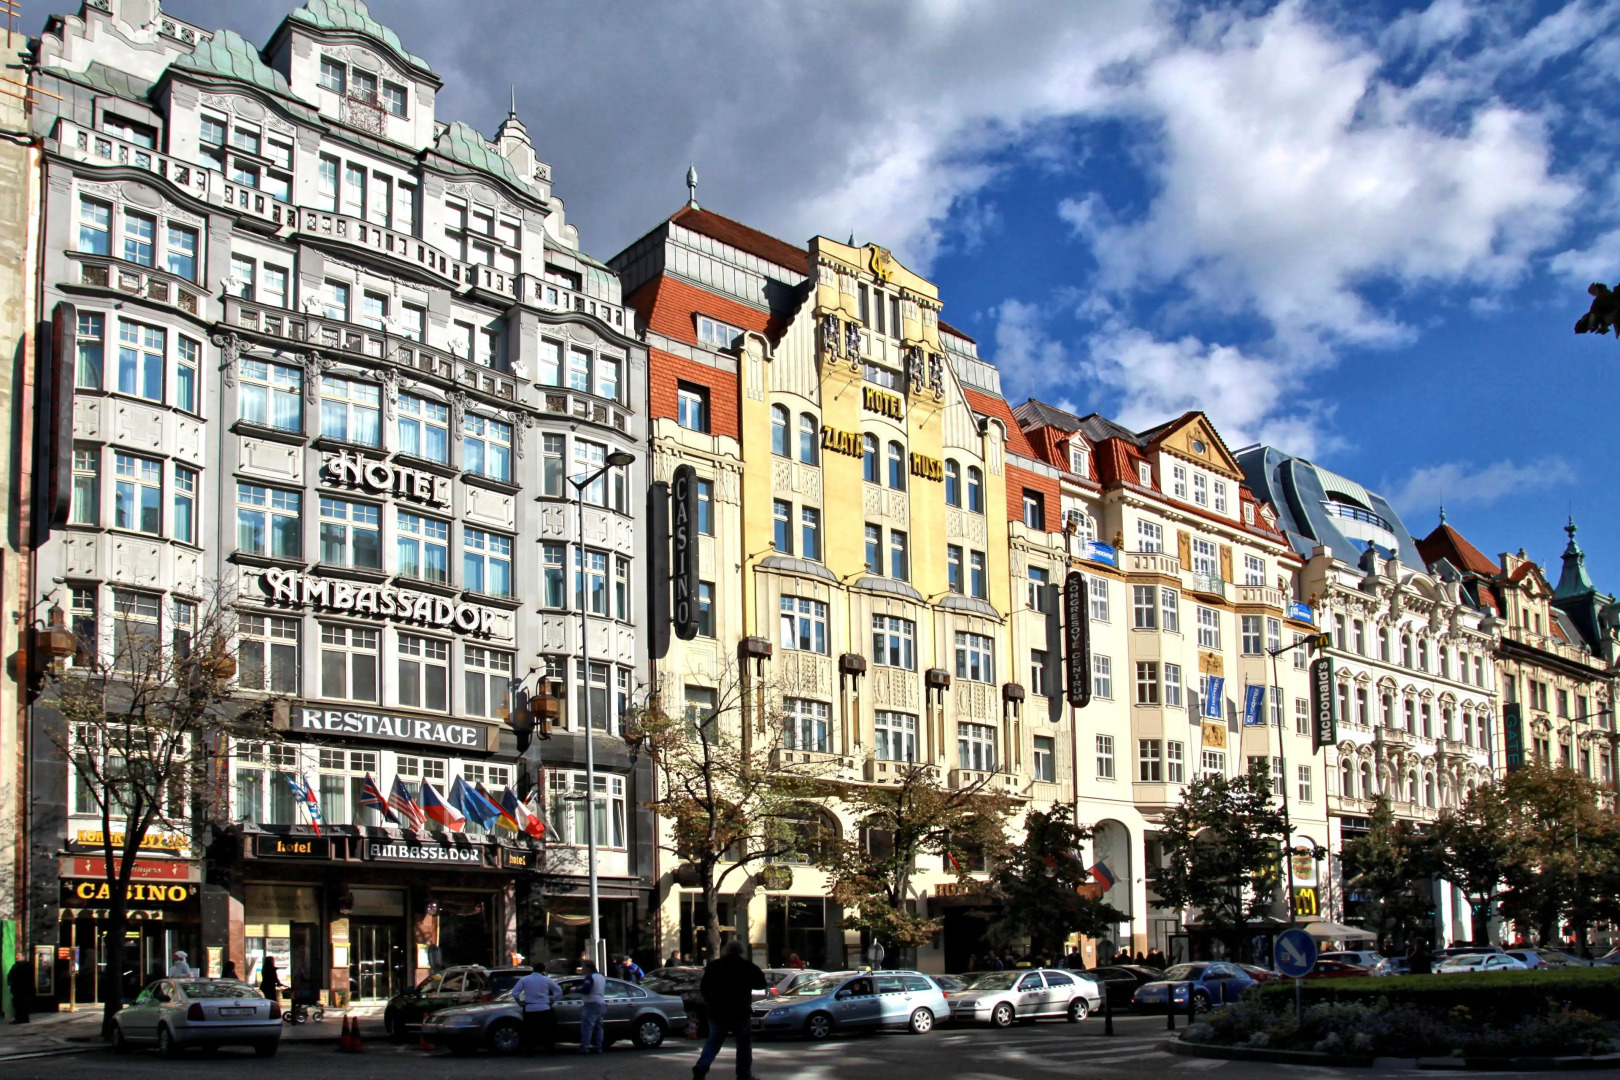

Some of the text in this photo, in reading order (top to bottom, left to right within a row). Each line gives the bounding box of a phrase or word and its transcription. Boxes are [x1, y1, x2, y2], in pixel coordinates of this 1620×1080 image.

[865, 386, 904, 420] HOTEL
[328, 449, 449, 505] HOTEL
[911, 452, 944, 482] HUSA
[675, 477, 689, 625] CASINO
[265, 567, 497, 635] AMBASSADOR
[1071, 653, 1083, 702] CENTRUM
[1318, 661, 1332, 742] McDonald's
[301, 708, 478, 746] RESTAURACE
[1505, 714, 1520, 766] GATE
[276, 840, 312, 854] hotel
[370, 843, 480, 861] AMBASSADOR
[508, 854, 526, 866] hotel
